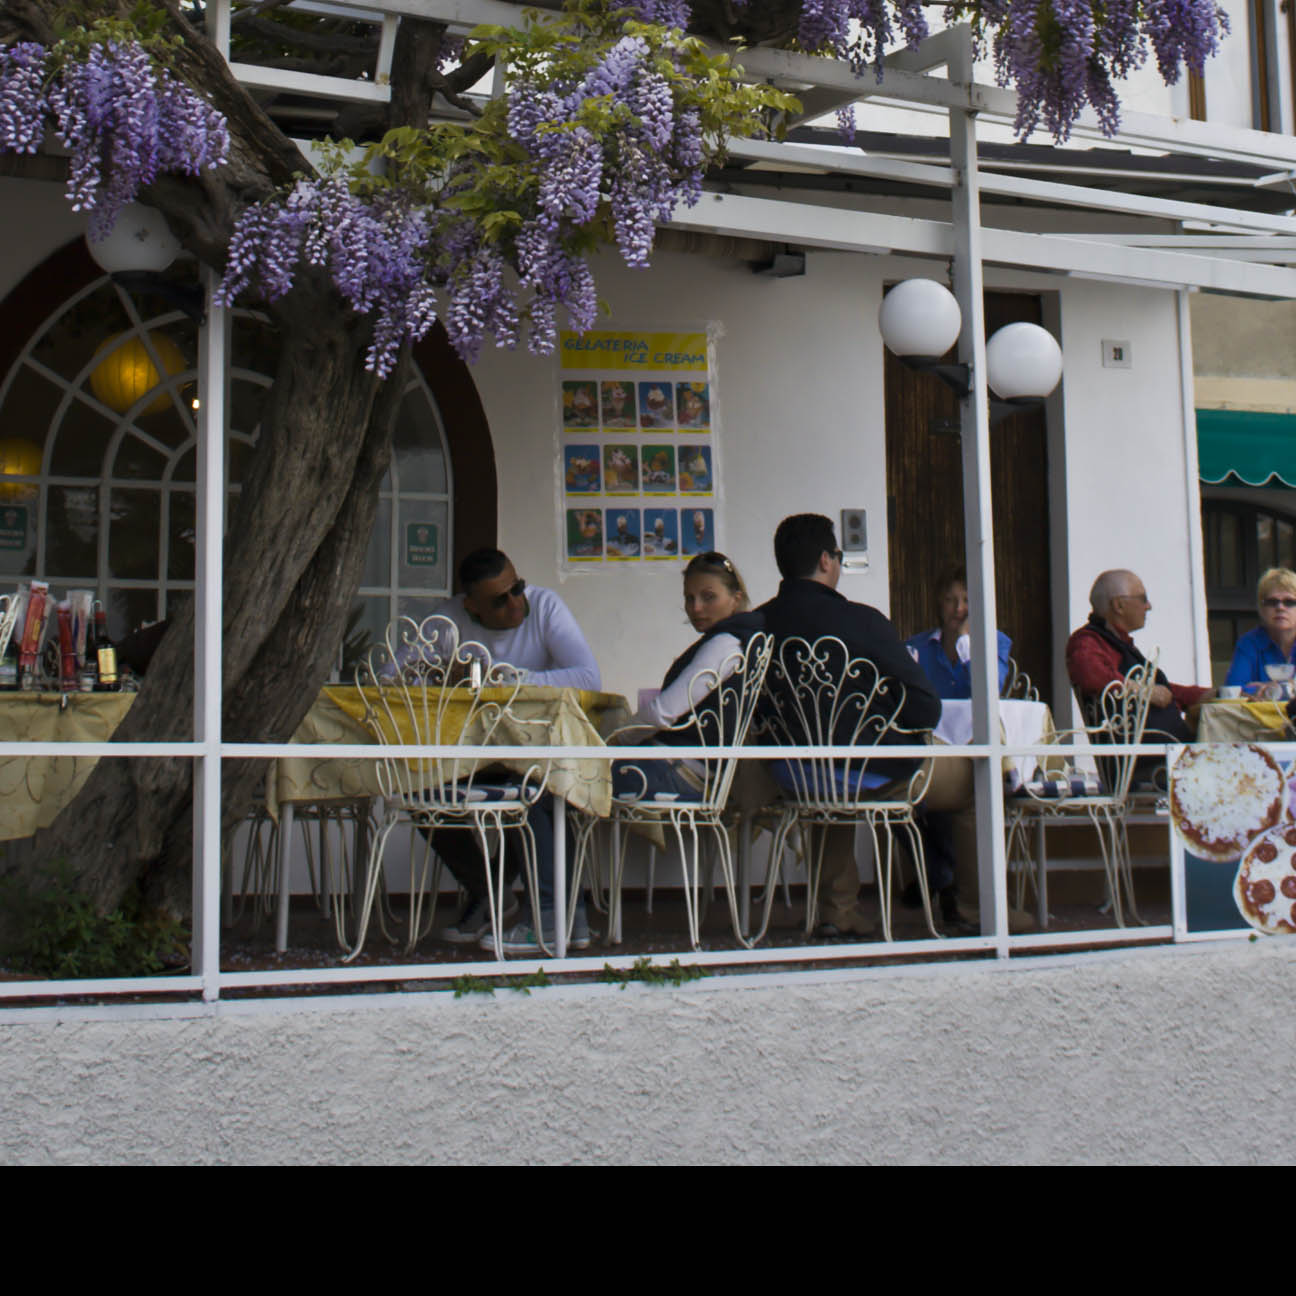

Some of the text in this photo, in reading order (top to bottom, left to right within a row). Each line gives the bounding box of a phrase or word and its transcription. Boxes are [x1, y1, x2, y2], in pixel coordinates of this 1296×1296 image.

[564, 338, 649, 352] GELATERIA
[624, 352, 705, 364] ICE CREAM
